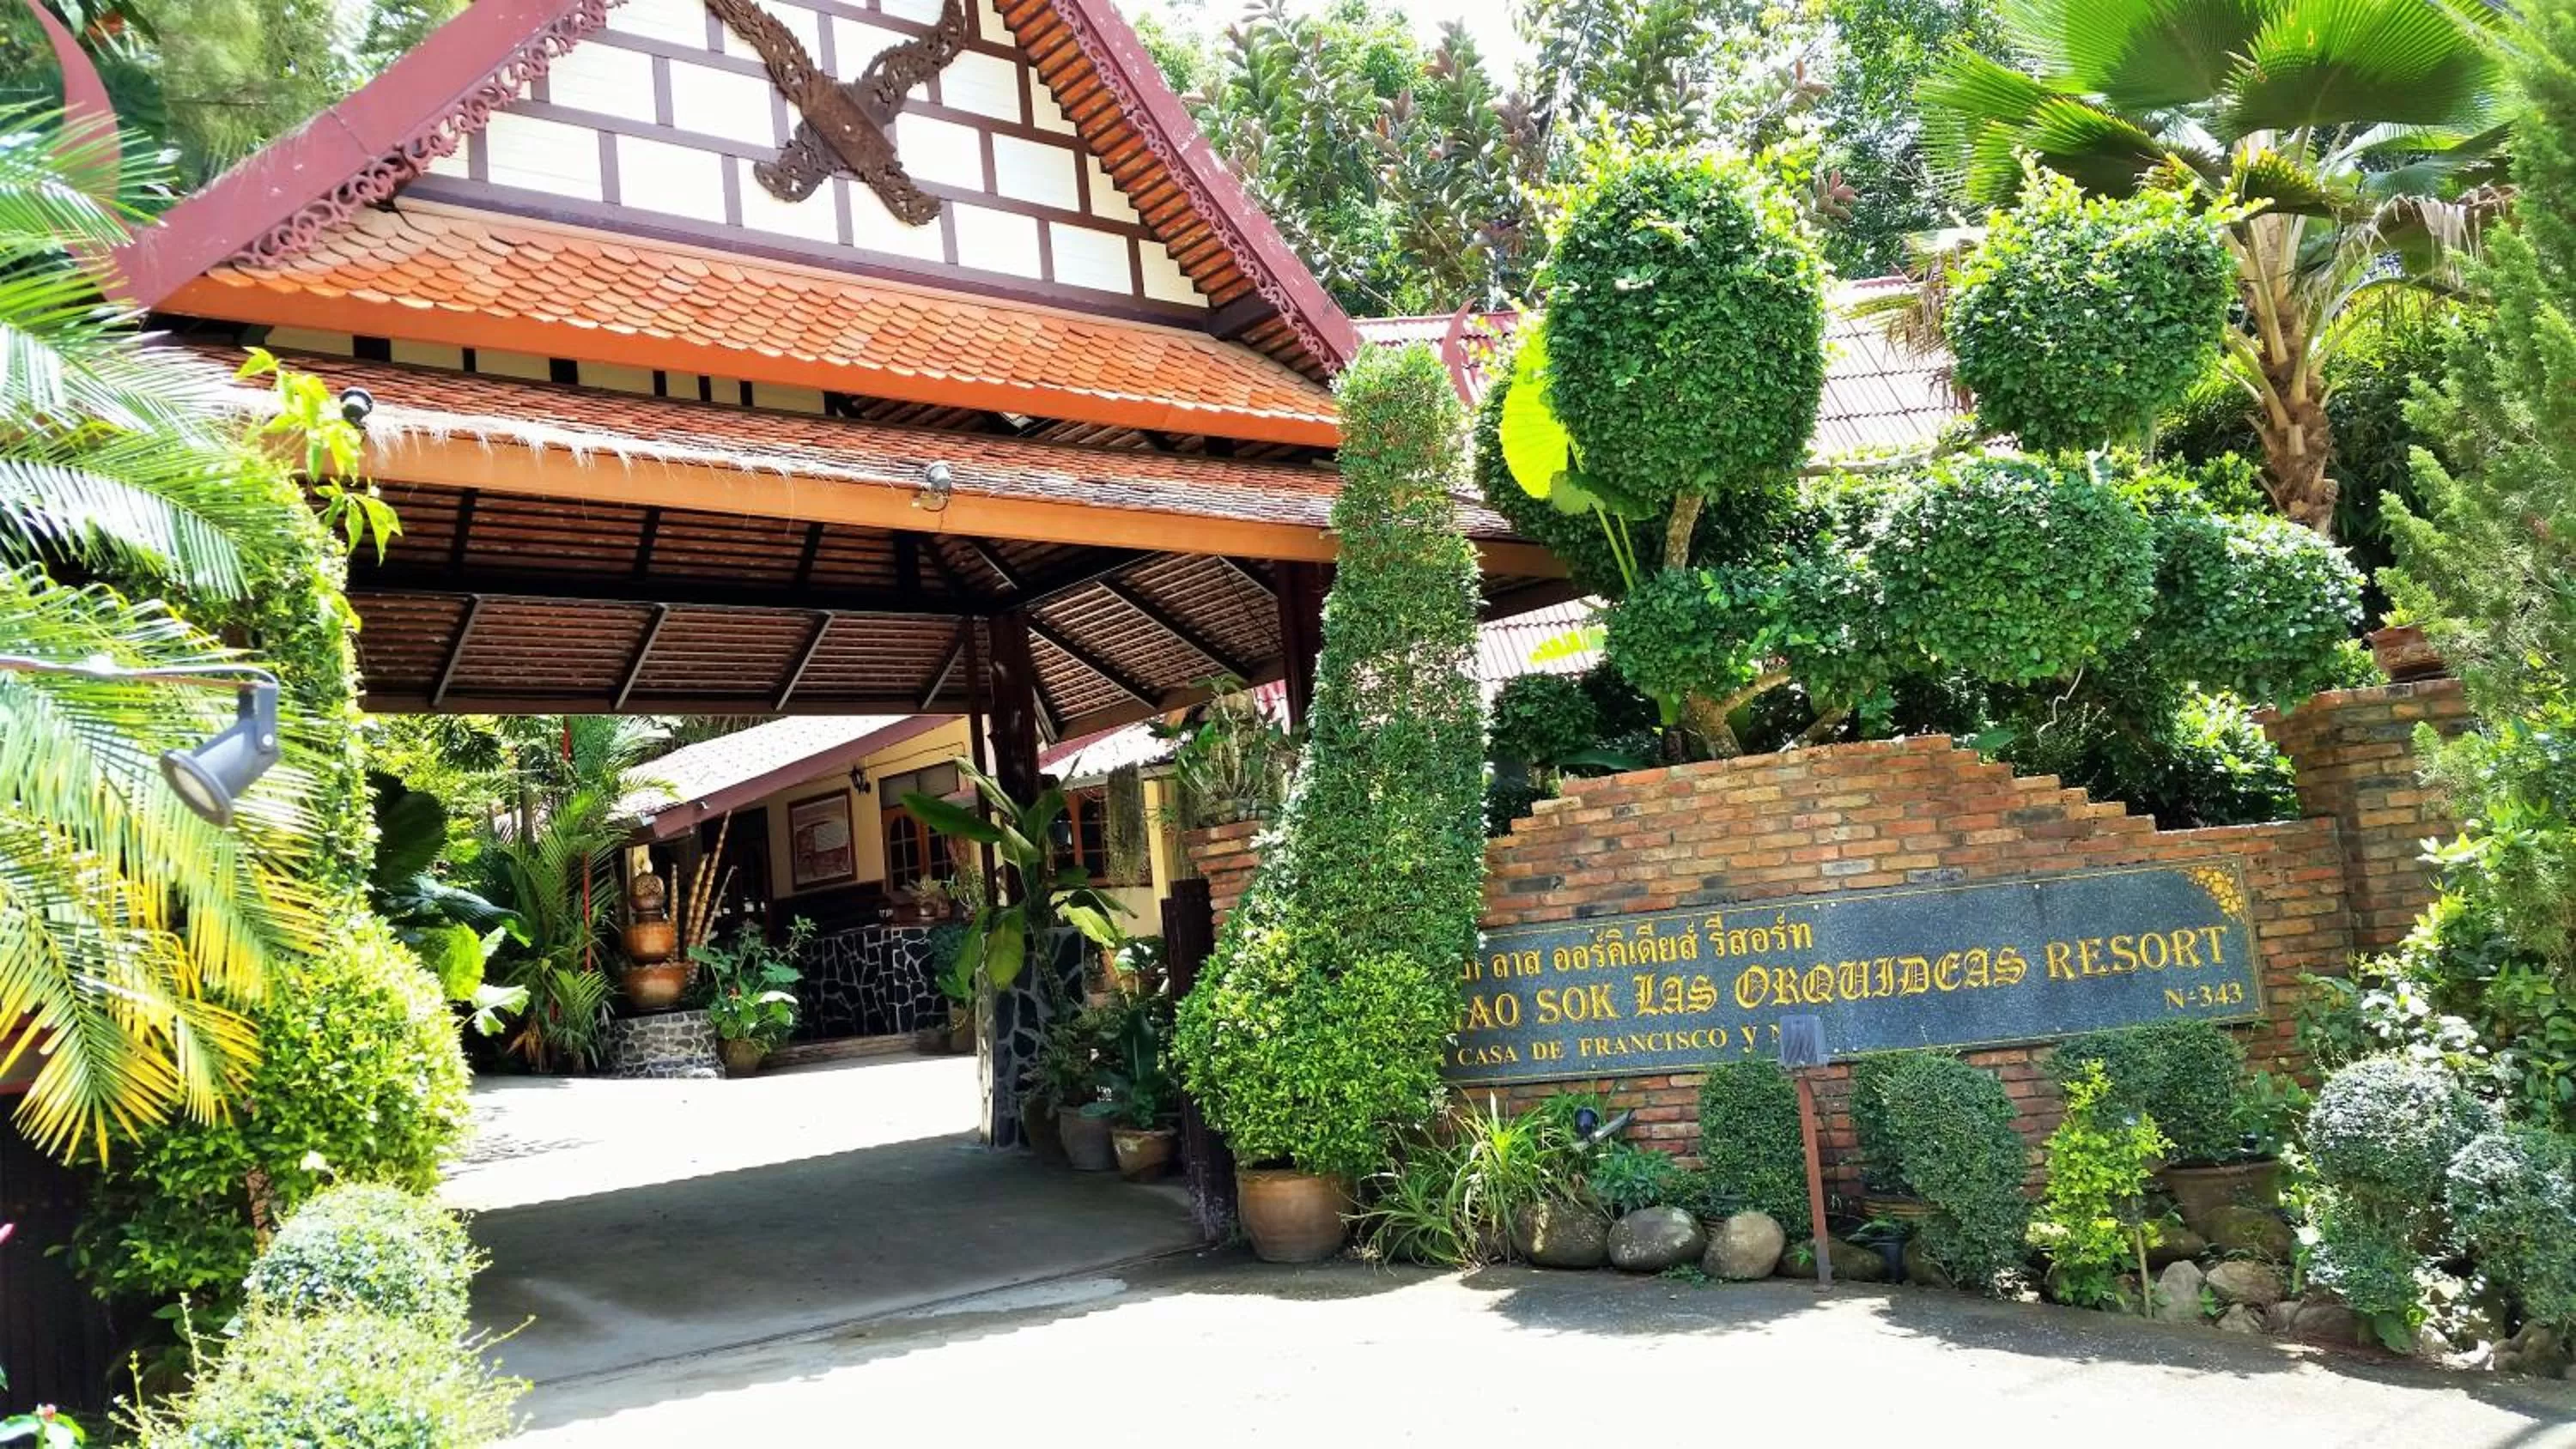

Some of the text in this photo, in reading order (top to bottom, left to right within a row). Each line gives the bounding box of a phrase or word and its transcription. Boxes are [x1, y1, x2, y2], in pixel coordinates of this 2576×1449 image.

[1455, 925, 2229, 1031] AO SOK LAS ORQUIDEAS RESORT
[1490, 948, 1542, 979] ลาส
[1705, 912, 1814, 958] รีสอร์ท
[1457, 1045, 1520, 1066] CASA
[1532, 1040, 1565, 1061] DE
[1579, 1028, 1728, 1058] FRANCISCO
